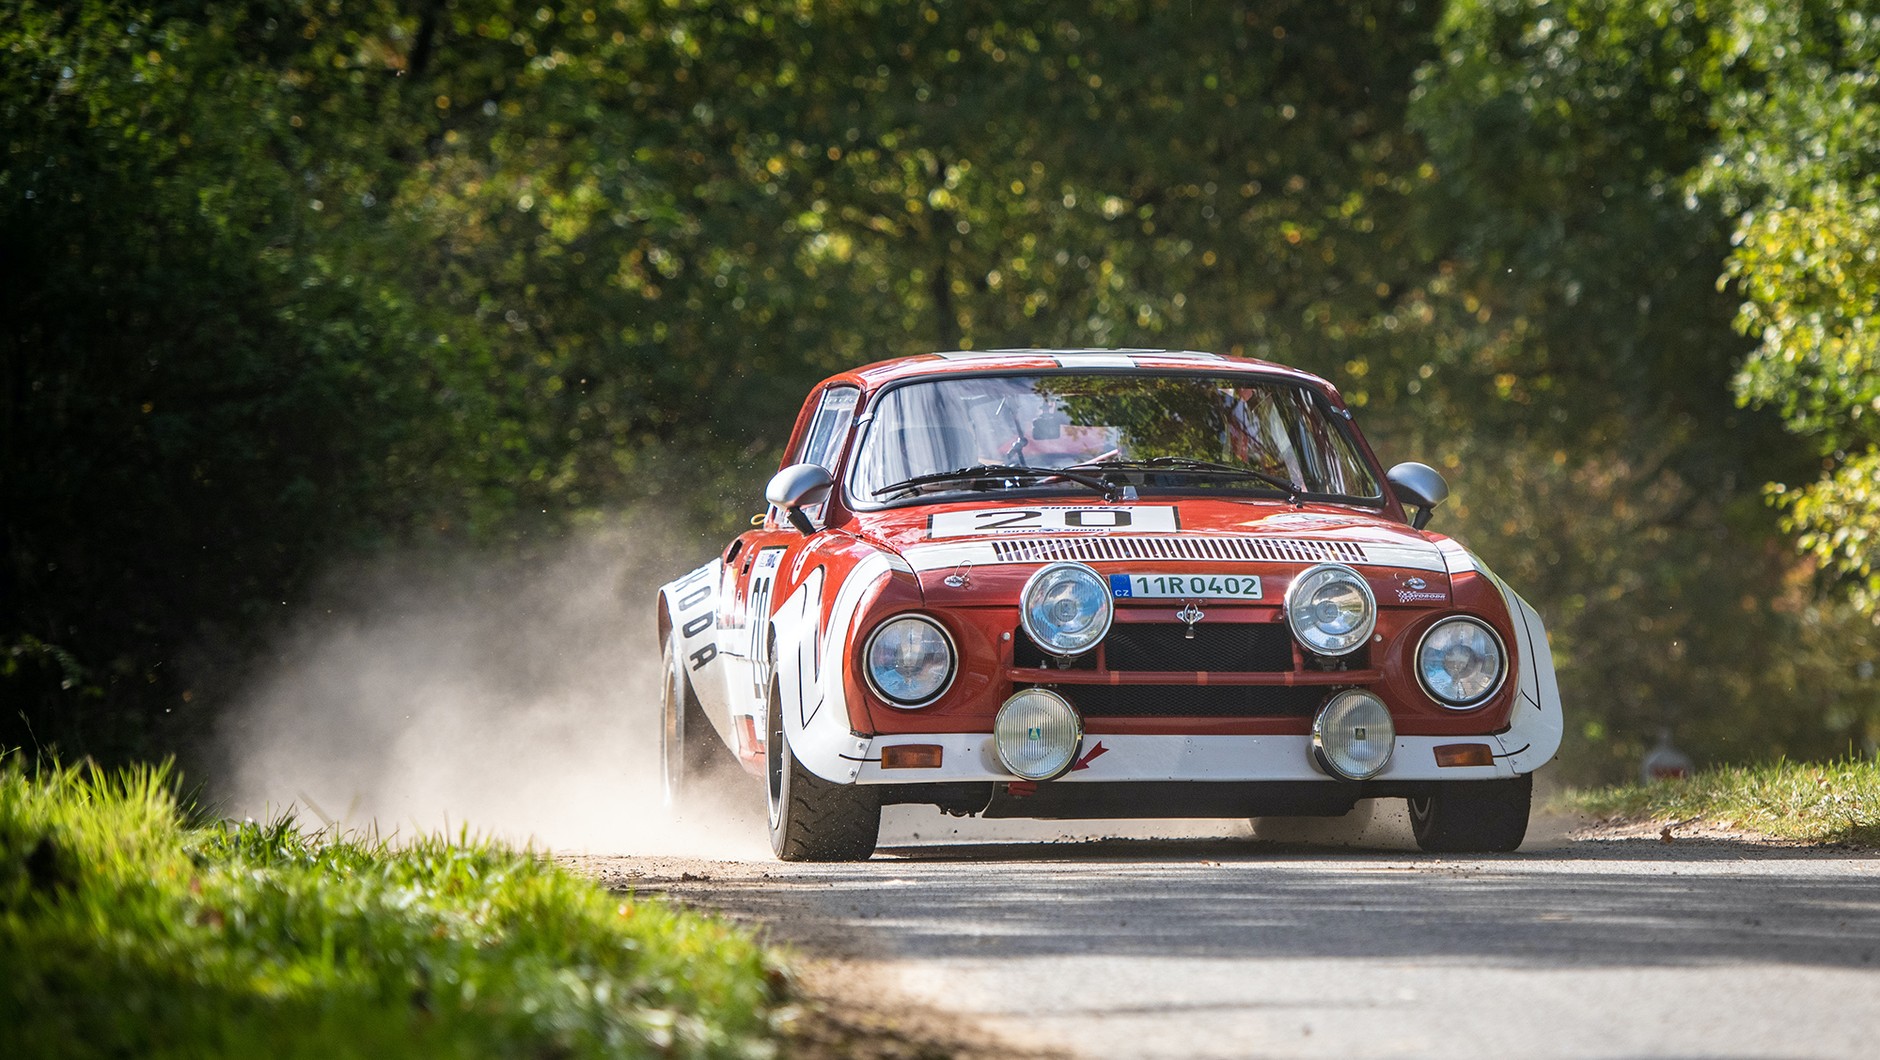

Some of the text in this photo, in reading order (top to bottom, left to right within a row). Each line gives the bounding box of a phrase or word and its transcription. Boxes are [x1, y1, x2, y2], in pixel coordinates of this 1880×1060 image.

[975, 510, 1132, 530] 20
[1114, 577, 1258, 597] CZ 11R 0402
[673, 562, 718, 672] KODA
